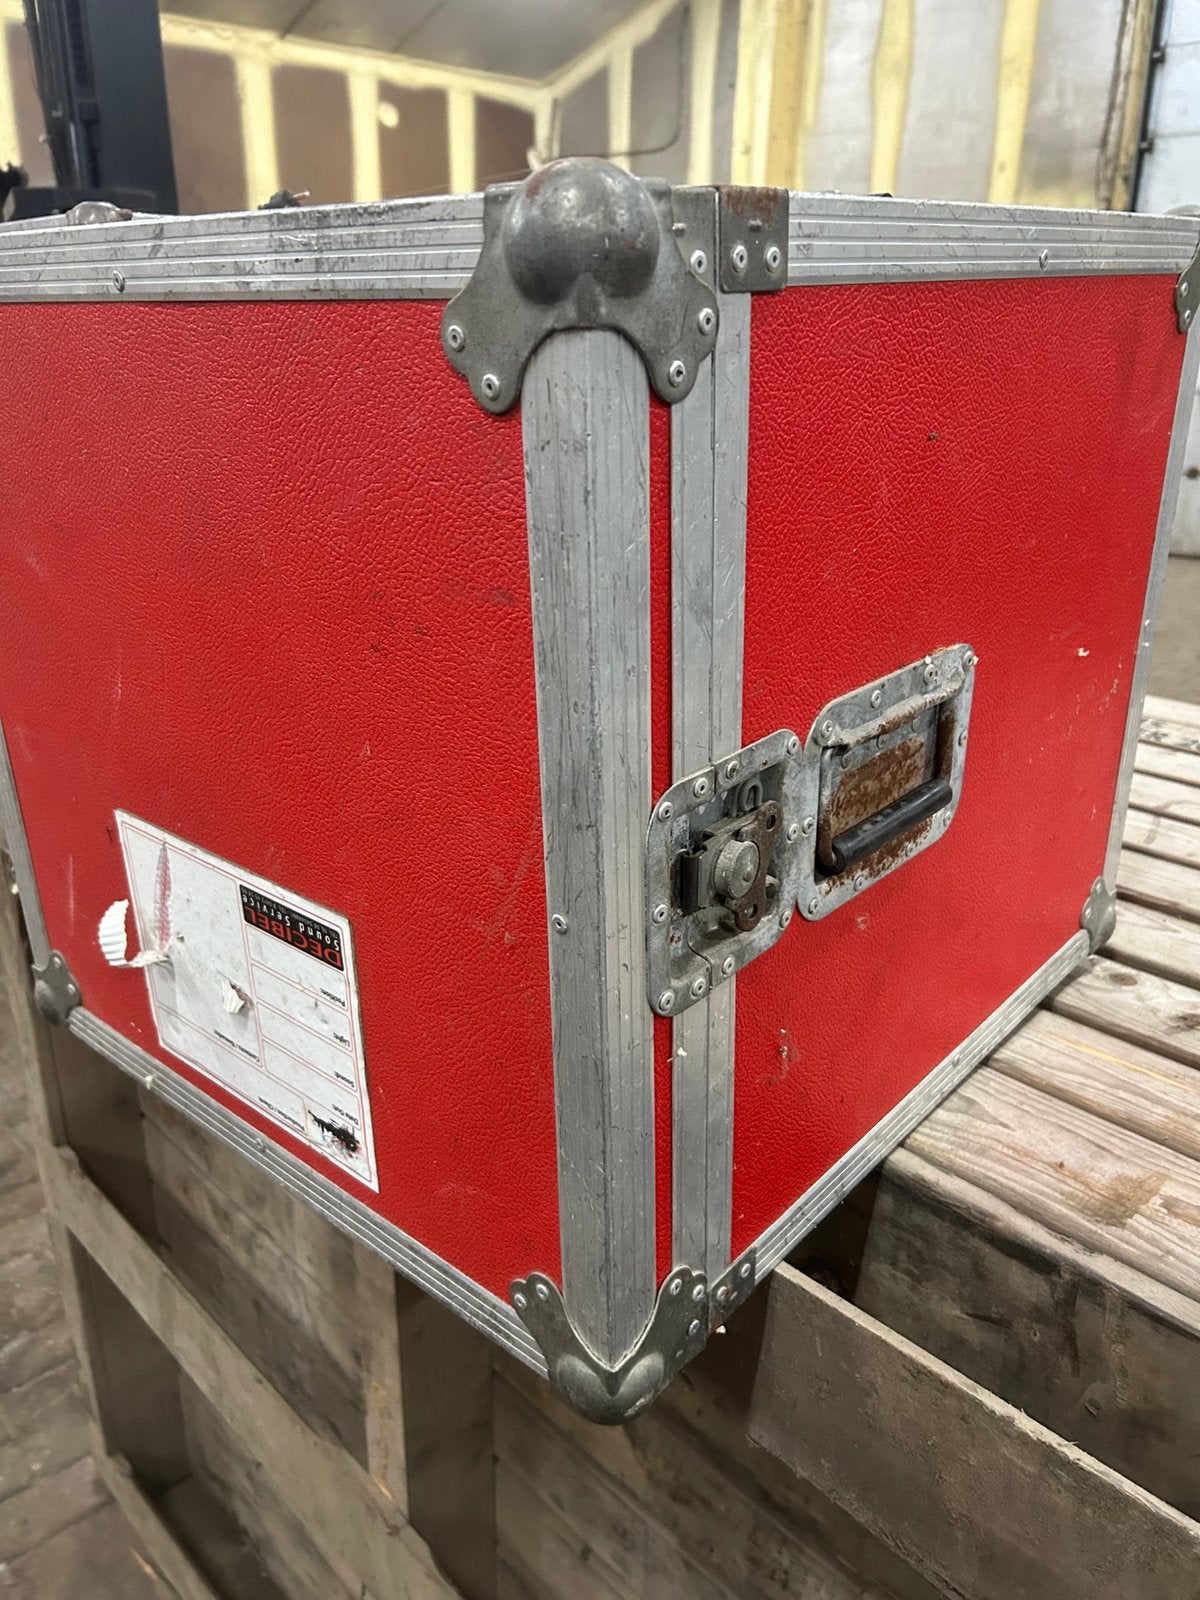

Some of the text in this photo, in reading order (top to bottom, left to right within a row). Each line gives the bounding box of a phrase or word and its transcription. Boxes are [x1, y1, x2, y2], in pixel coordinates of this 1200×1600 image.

[242, 893, 339, 951] Sound Service
[243, 905, 341, 967] DECIBEL
[320, 987, 345, 1007] Position:
[333, 1031, 349, 1047] Light:
[334, 1070, 354, 1088] Sound:
[345, 1112, 358, 1125] Date
